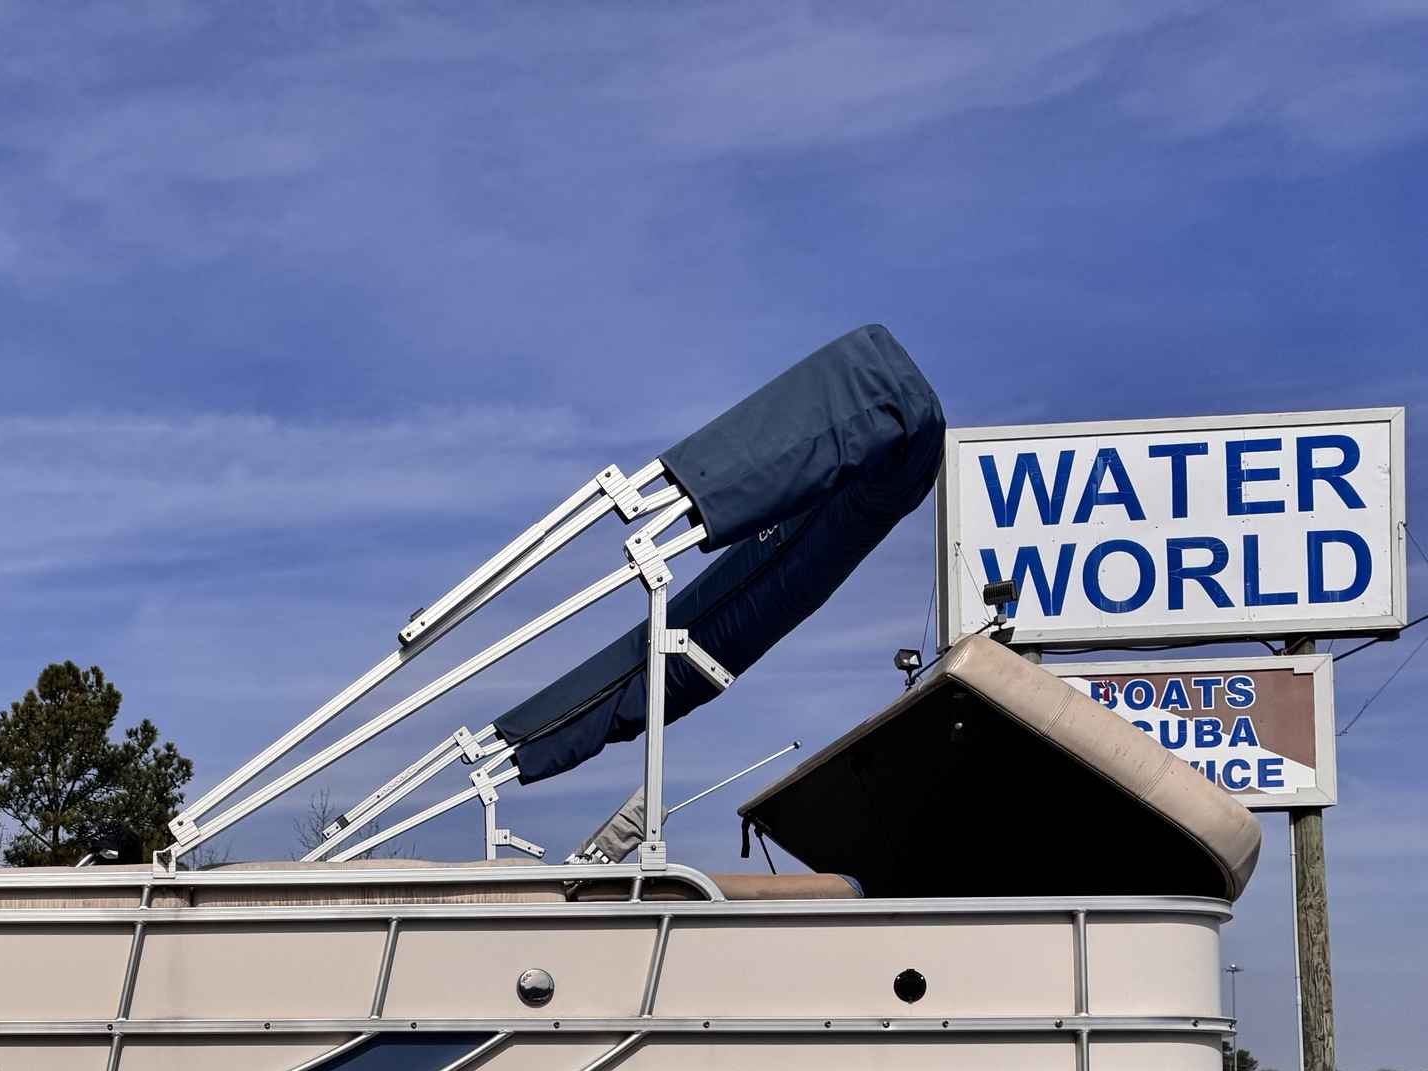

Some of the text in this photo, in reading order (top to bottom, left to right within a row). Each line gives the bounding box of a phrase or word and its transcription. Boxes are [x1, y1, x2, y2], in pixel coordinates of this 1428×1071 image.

[978, 434, 1367, 528] WATER
[979, 529, 1373, 618] WORLD
[1089, 675, 1255, 710] BOATS
